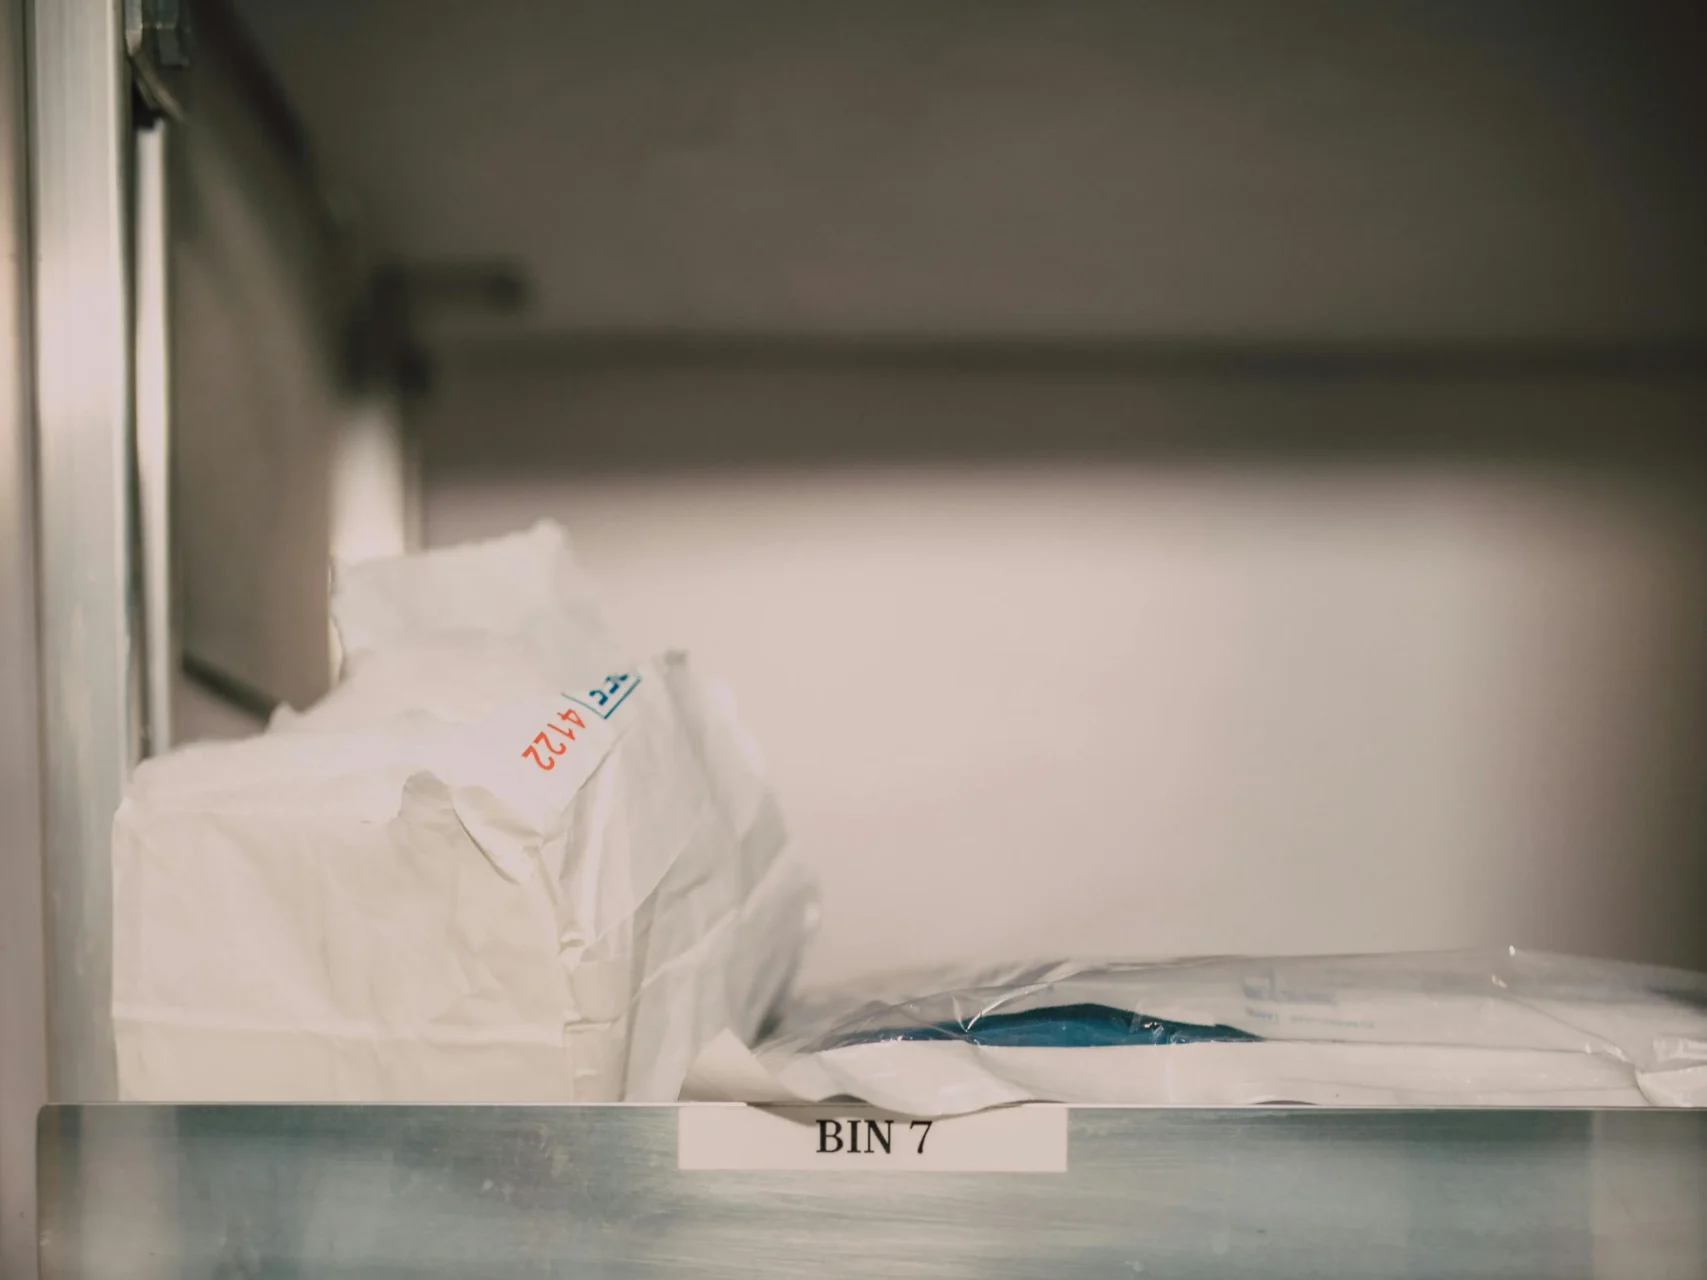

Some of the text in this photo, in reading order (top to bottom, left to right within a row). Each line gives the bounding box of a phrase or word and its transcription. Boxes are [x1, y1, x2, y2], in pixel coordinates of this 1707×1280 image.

[521, 708, 586, 771] 4122
[815, 1119, 935, 1154] BIN 7
